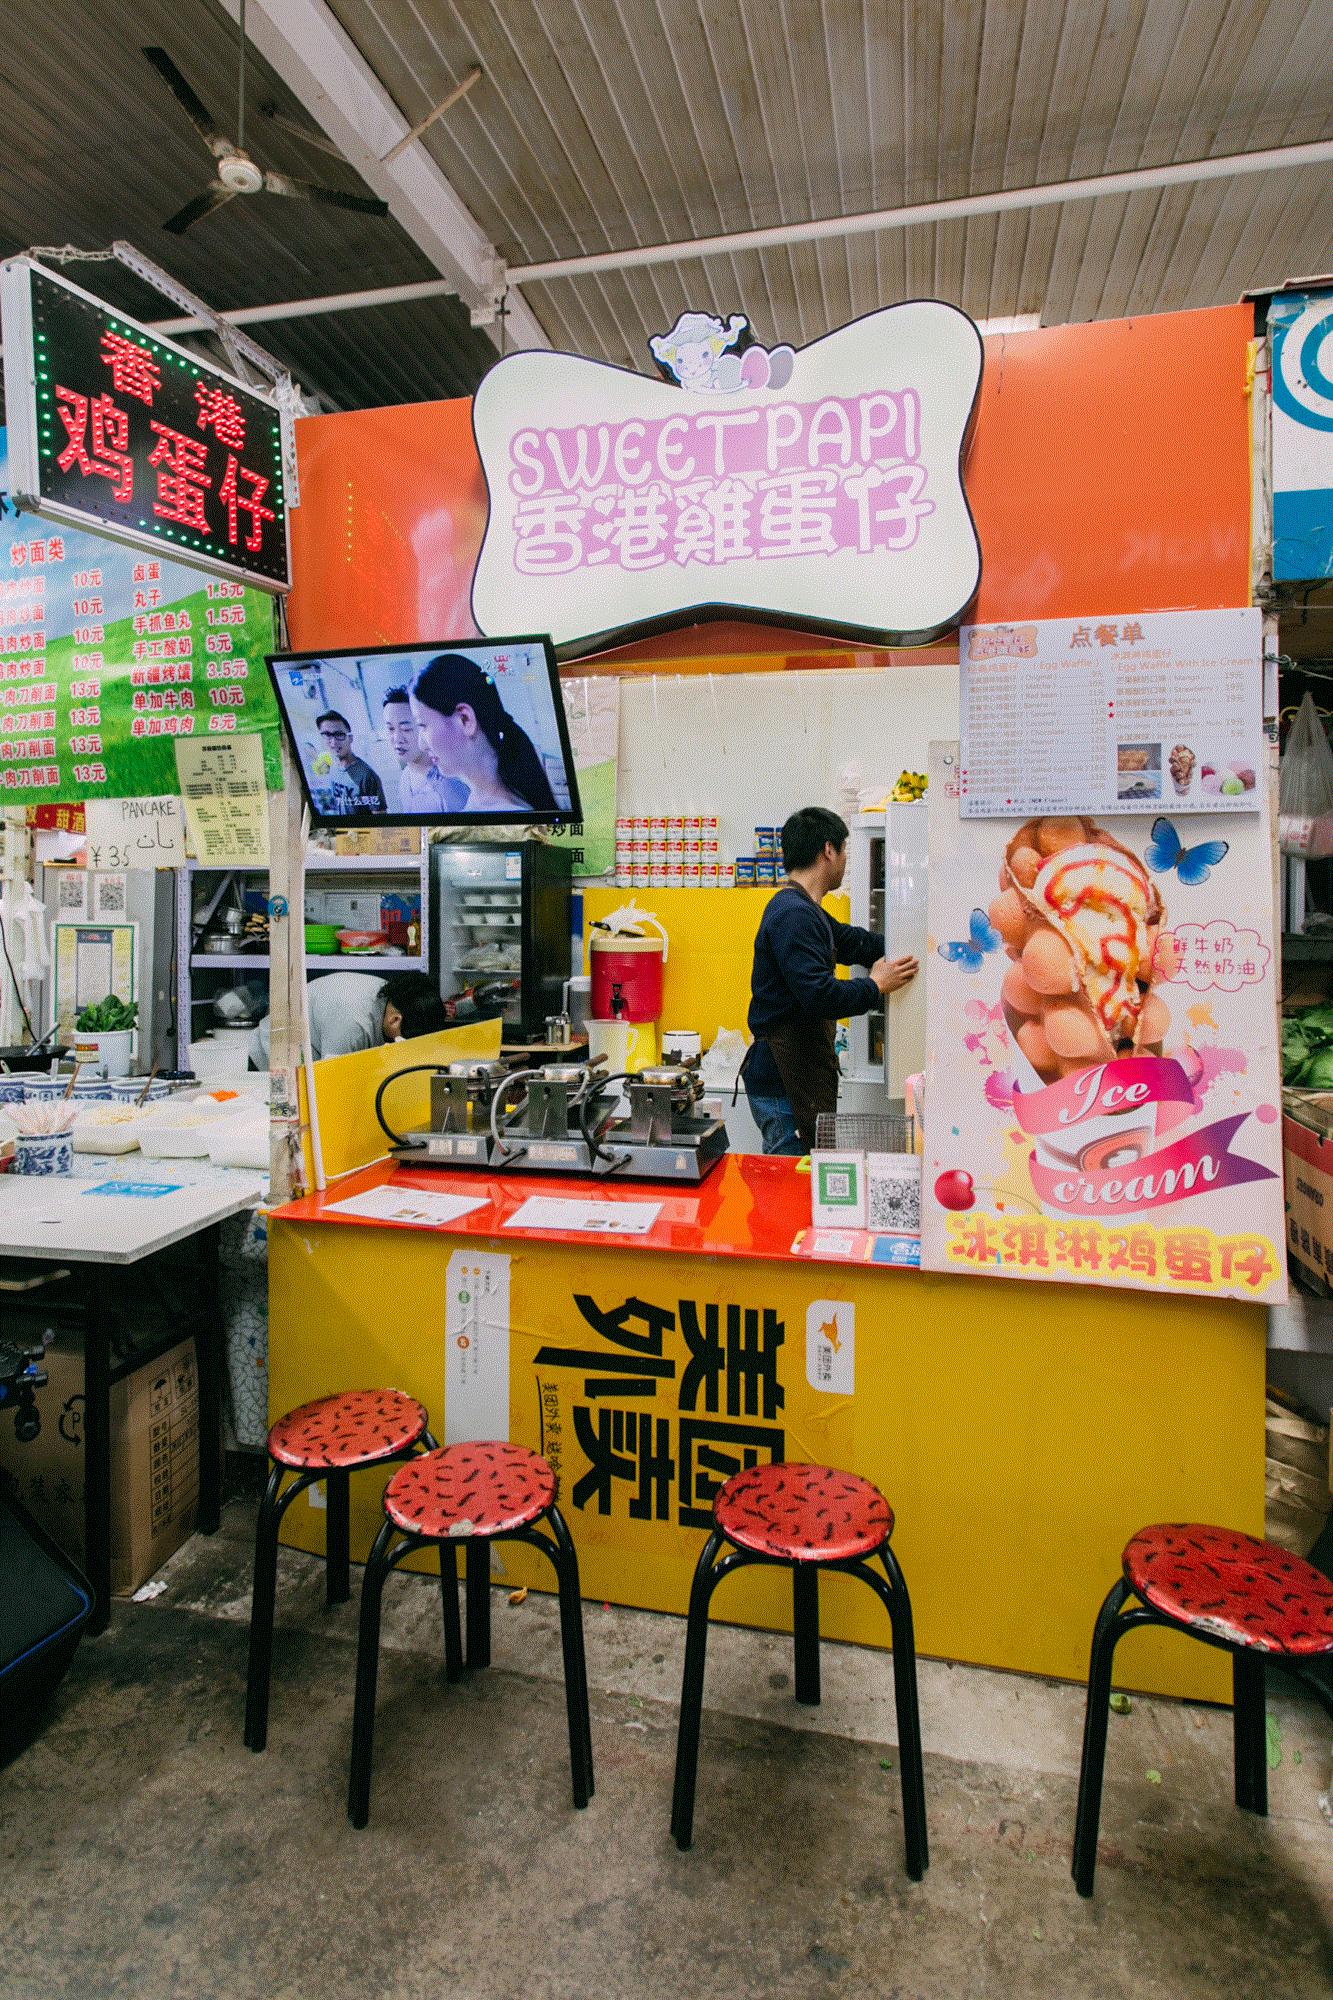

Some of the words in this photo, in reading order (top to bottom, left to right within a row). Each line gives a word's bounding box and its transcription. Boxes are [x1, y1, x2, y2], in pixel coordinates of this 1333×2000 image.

[100, 328, 246, 450] 香港
[511, 408, 760, 497] SWEET
[766, 391, 919, 471] PAPI
[55, 384, 275, 551] 鸡蛋仔
[10, 536, 65, 566] 炒面类
[73, 568, 102, 590] 10元
[133, 562, 160, 583] 卤蛋
[74, 597, 103, 617] 10元
[135, 589, 160, 608] 丸子
[207, 582, 244, 599] 1.5元
[133, 610, 191, 635] 手抓鱼丸
[207, 605, 245, 625] 1.5元
[74, 625, 104, 645] 10元
[134, 636, 192, 660] 手工酸奶
[206, 634, 232, 653] 5元
[1070, 622, 1146, 649] 点餐单
[74, 652, 102, 671] 10元
[207, 659, 247, 678] 3.5元
[1219, 656, 1254, 667] Cream
[0, 684, 56, 706] 肉刀削面
[70, 679, 100, 698] 13元
[133, 688, 194, 711] 单加牛肉
[210, 686, 244, 706] 10元
[71, 707, 100, 726] 13元
[133, 715, 193, 736] 单加鸡肉
[209, 713, 236, 731] 5元
[70, 735, 102, 753] 13元
[0, 767, 59, 788] 肉刀削面
[74, 764, 106, 783] 13元
[122, 801, 176, 820] PANCAKE
[551, 823, 584, 838] 炒面
[570, 848, 585, 864] 面
[1171, 938, 1234, 953] 鲜牛奶
[1174, 958, 1257, 977] 天然奶油
[1059, 1069, 1150, 1125] Ice
[1053, 1153, 1222, 1205] cream
[950, 1217, 1272, 1288] 冰淇淋鸡蛋仔
[532, 1293, 676, 1521] 外卖
[542, 1383, 562, 1435] 美团外卖
[678, 1299, 785, 1528] 美团
